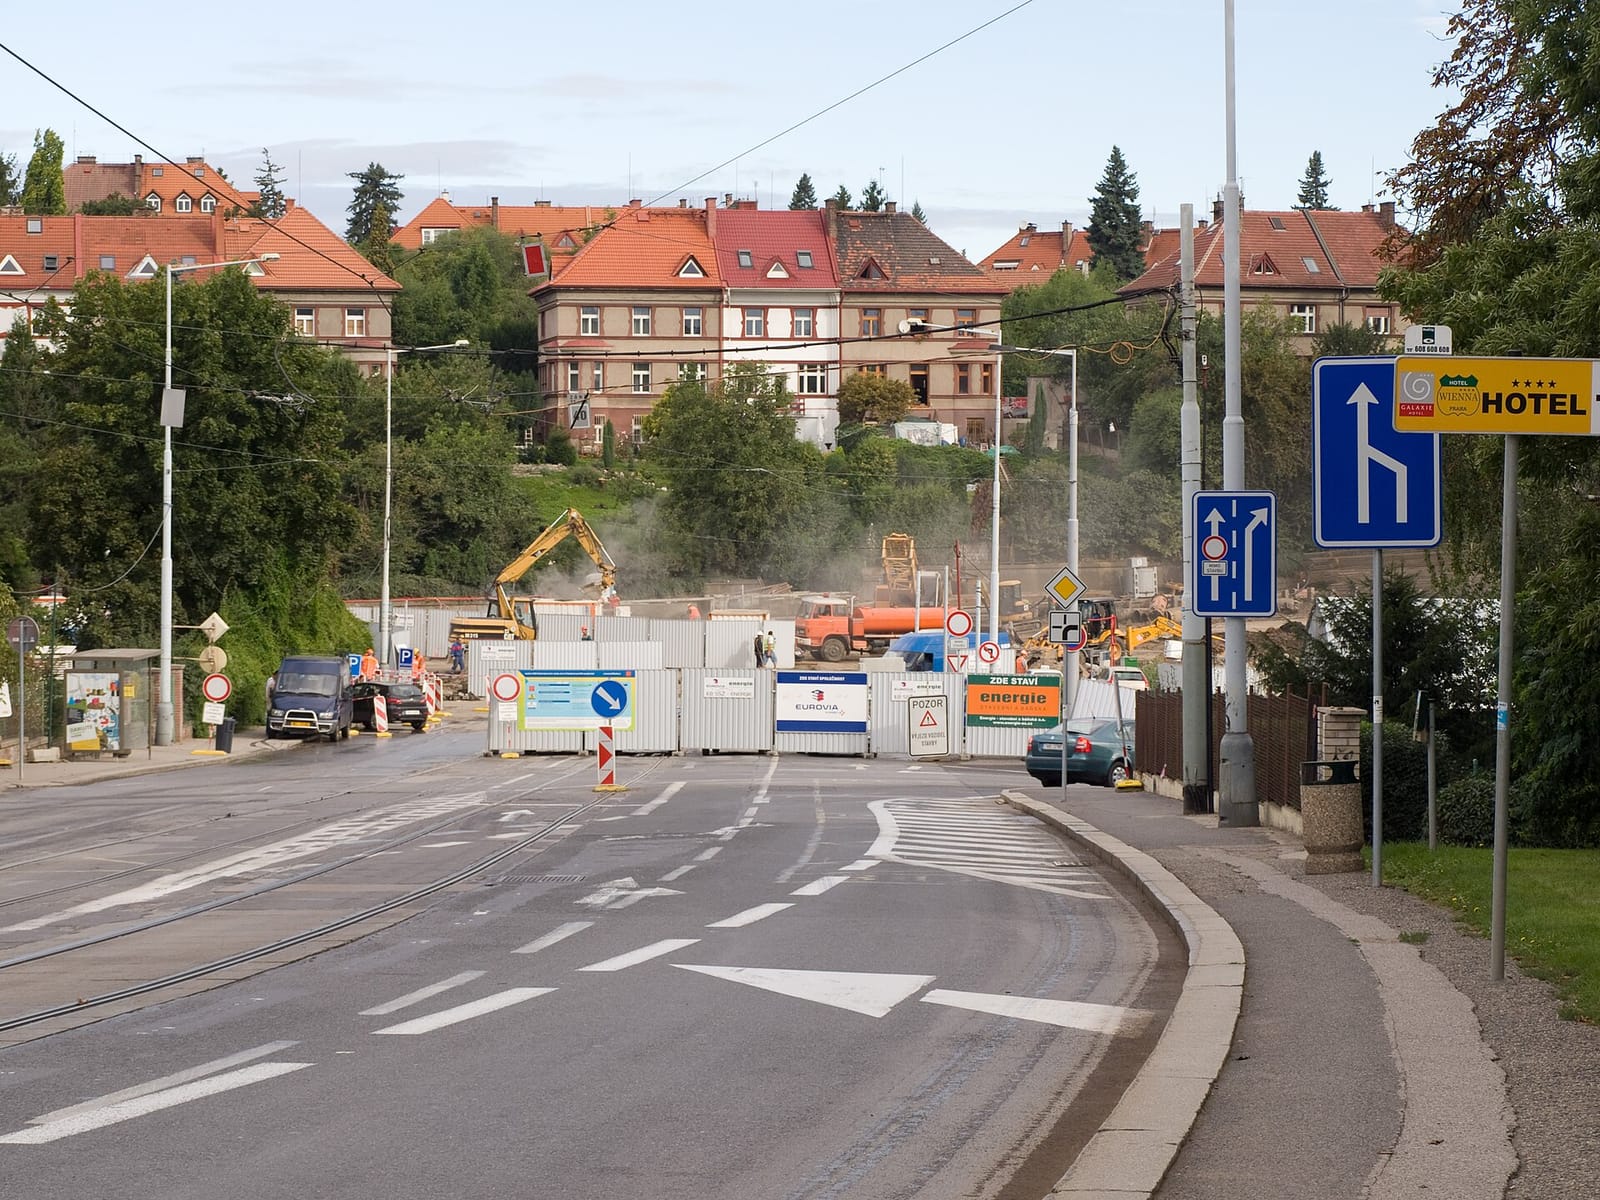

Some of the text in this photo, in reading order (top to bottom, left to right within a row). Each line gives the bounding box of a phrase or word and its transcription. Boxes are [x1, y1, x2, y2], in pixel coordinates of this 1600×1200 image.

[1439, 392, 1478, 401] WIENNA
[1481, 392, 1587, 415] HOTEL
[402, 650, 411, 663] P
[349, 657, 359, 667] P
[989, 677, 1038, 686] ZDE STAVÍ
[980, 692, 1047, 705] energie
[912, 699, 943, 709] POZOR
